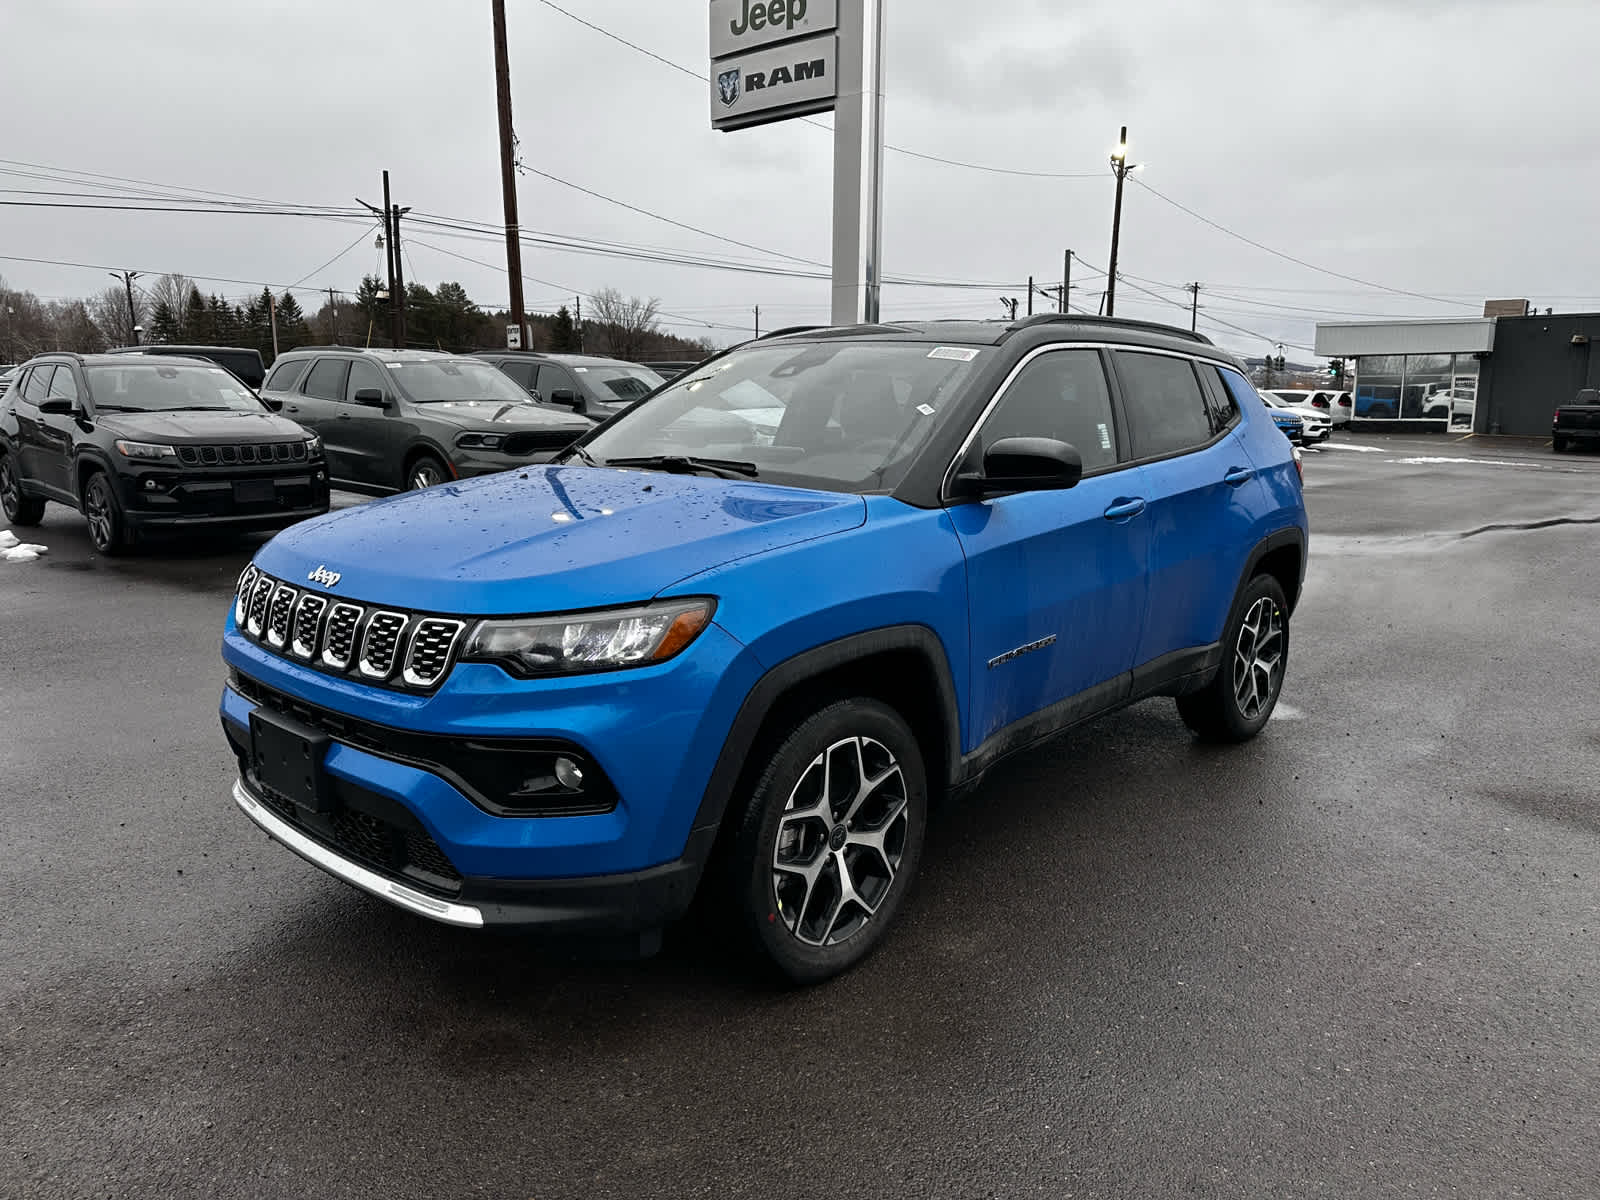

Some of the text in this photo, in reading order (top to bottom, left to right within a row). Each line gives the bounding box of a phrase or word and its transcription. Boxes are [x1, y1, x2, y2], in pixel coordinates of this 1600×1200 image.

[730, 0, 807, 35] Jeep
[745, 58, 825, 92] RAM
[308, 565, 341, 588] Jeep
